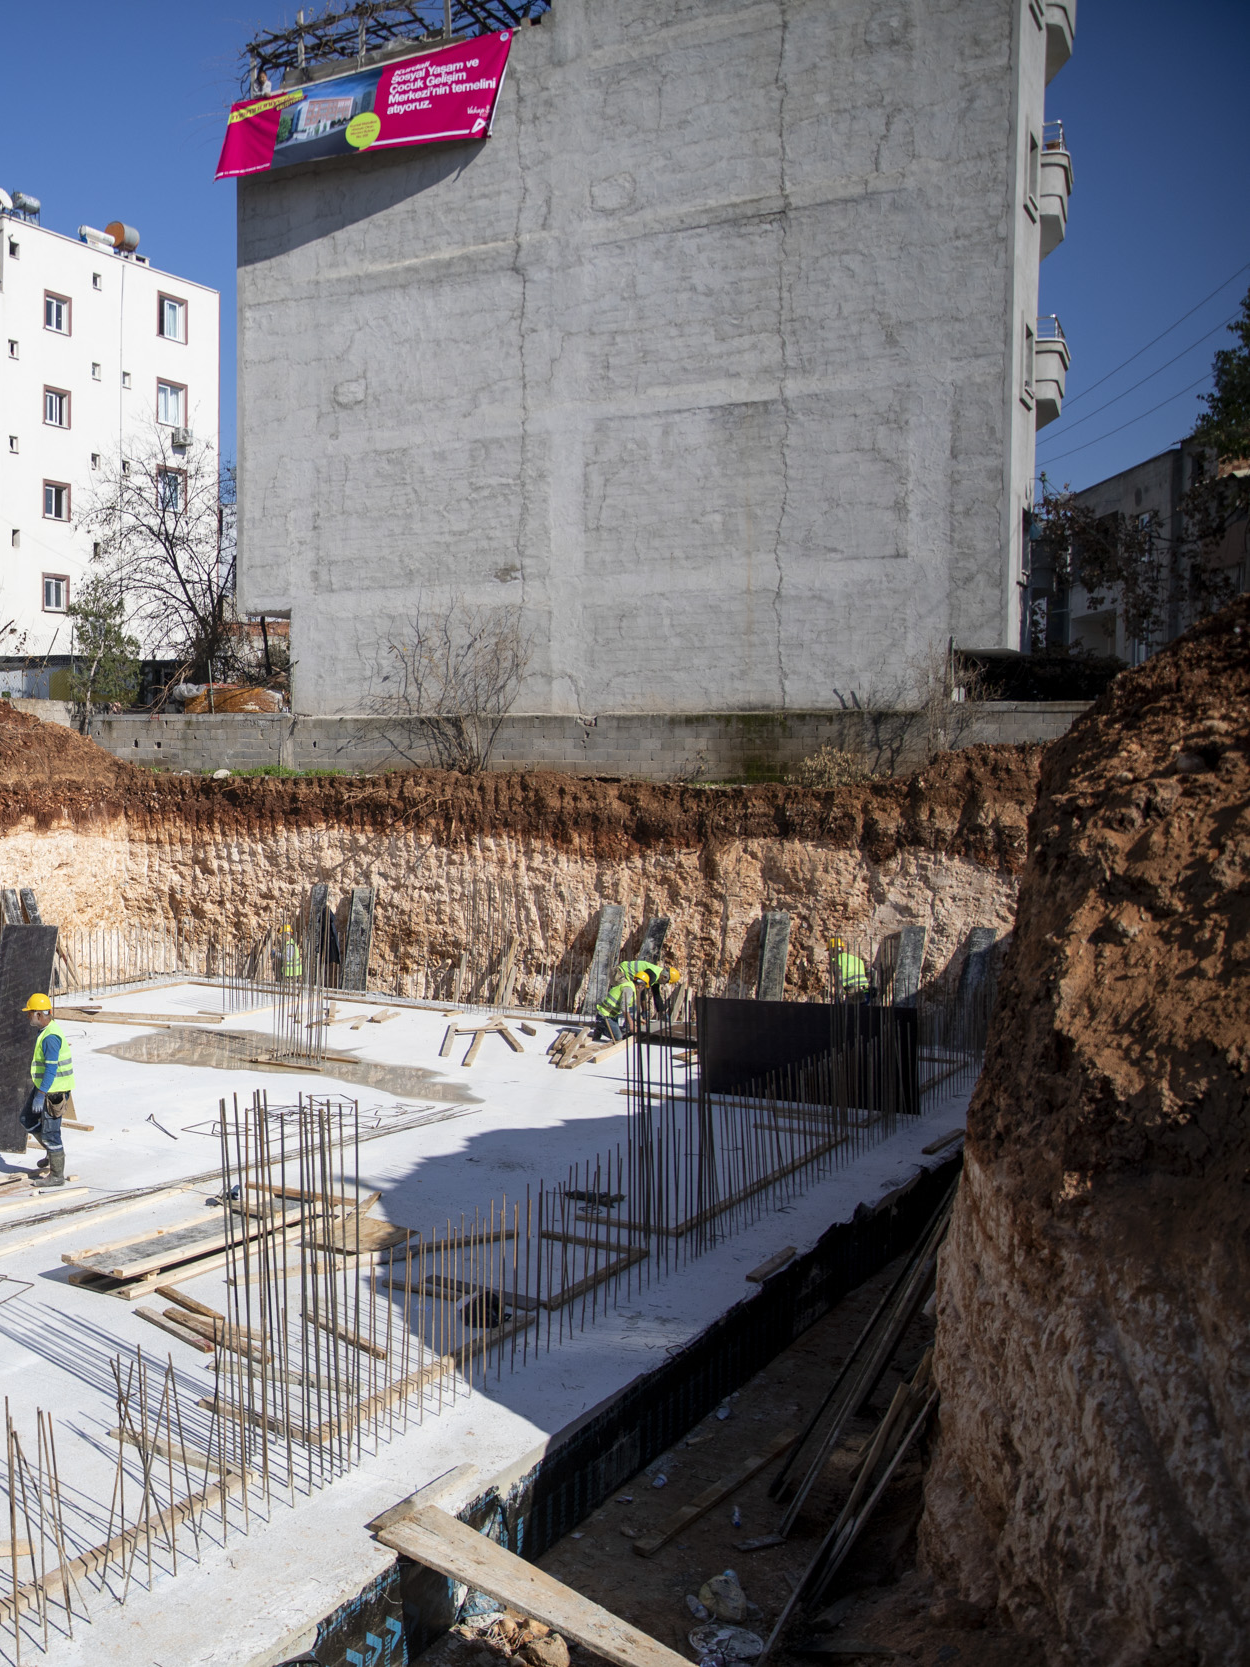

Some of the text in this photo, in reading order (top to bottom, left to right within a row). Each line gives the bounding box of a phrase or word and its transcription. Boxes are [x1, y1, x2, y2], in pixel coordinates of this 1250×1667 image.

[391, 58, 480, 84] Sosyal Yaşam ve
[389, 71, 467, 96] Çocuk Gelişim
[451, 77, 497, 93] temelini
[386, 99, 432, 115] atıyoruz.
